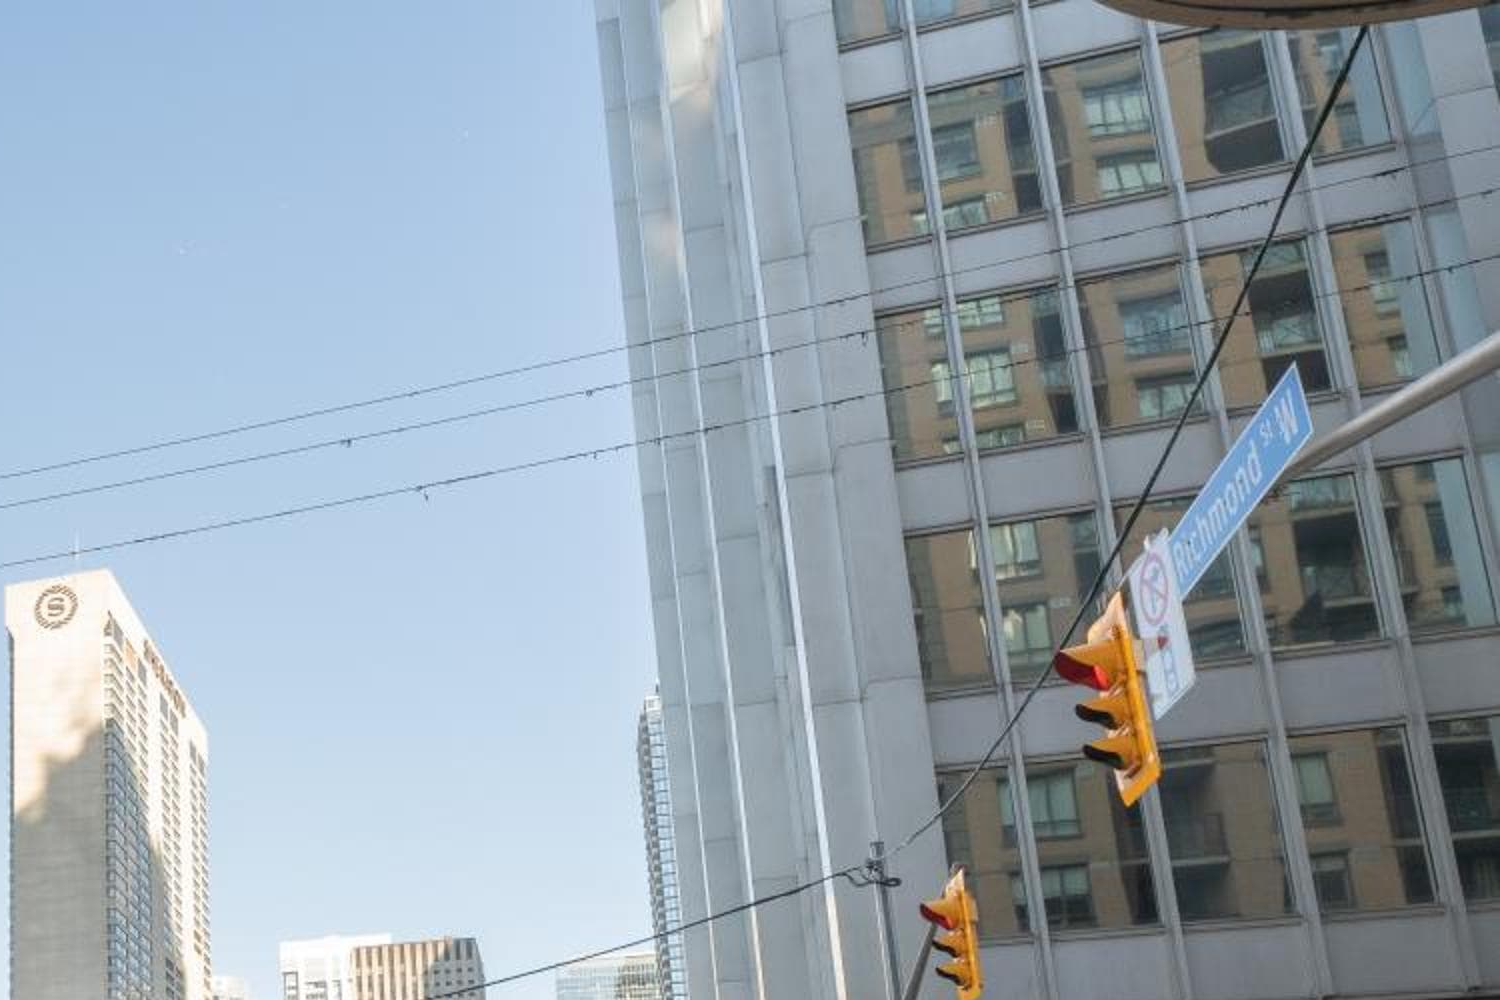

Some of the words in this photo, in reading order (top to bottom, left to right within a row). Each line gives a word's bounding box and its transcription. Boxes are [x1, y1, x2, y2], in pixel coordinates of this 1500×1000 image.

[1173, 440, 1262, 579] Richmond
[1274, 387, 1299, 444] W
[47, 597, 65, 617] S
